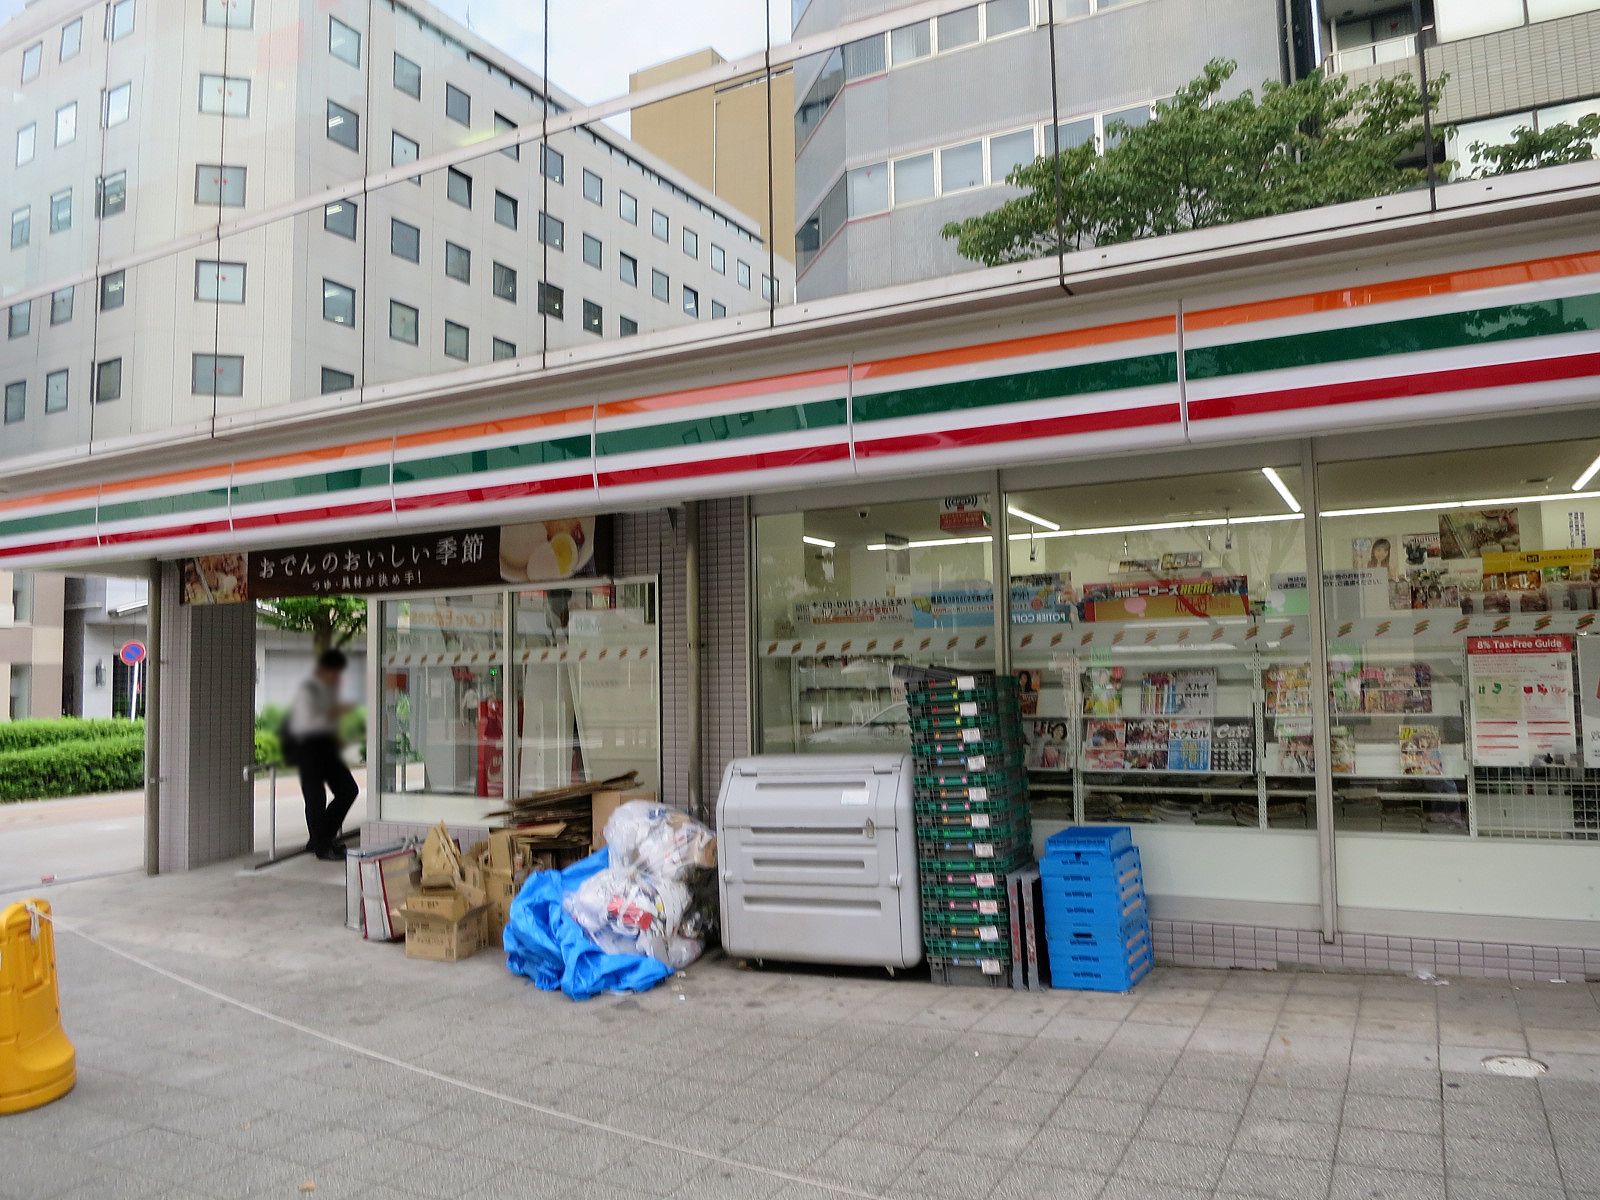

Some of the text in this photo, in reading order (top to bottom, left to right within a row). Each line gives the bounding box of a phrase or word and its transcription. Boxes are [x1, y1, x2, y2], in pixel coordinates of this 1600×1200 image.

[259, 533, 484, 579] おでんのおいしい季節
[1477, 638, 1562, 650] 8% Tax-Free Guide
